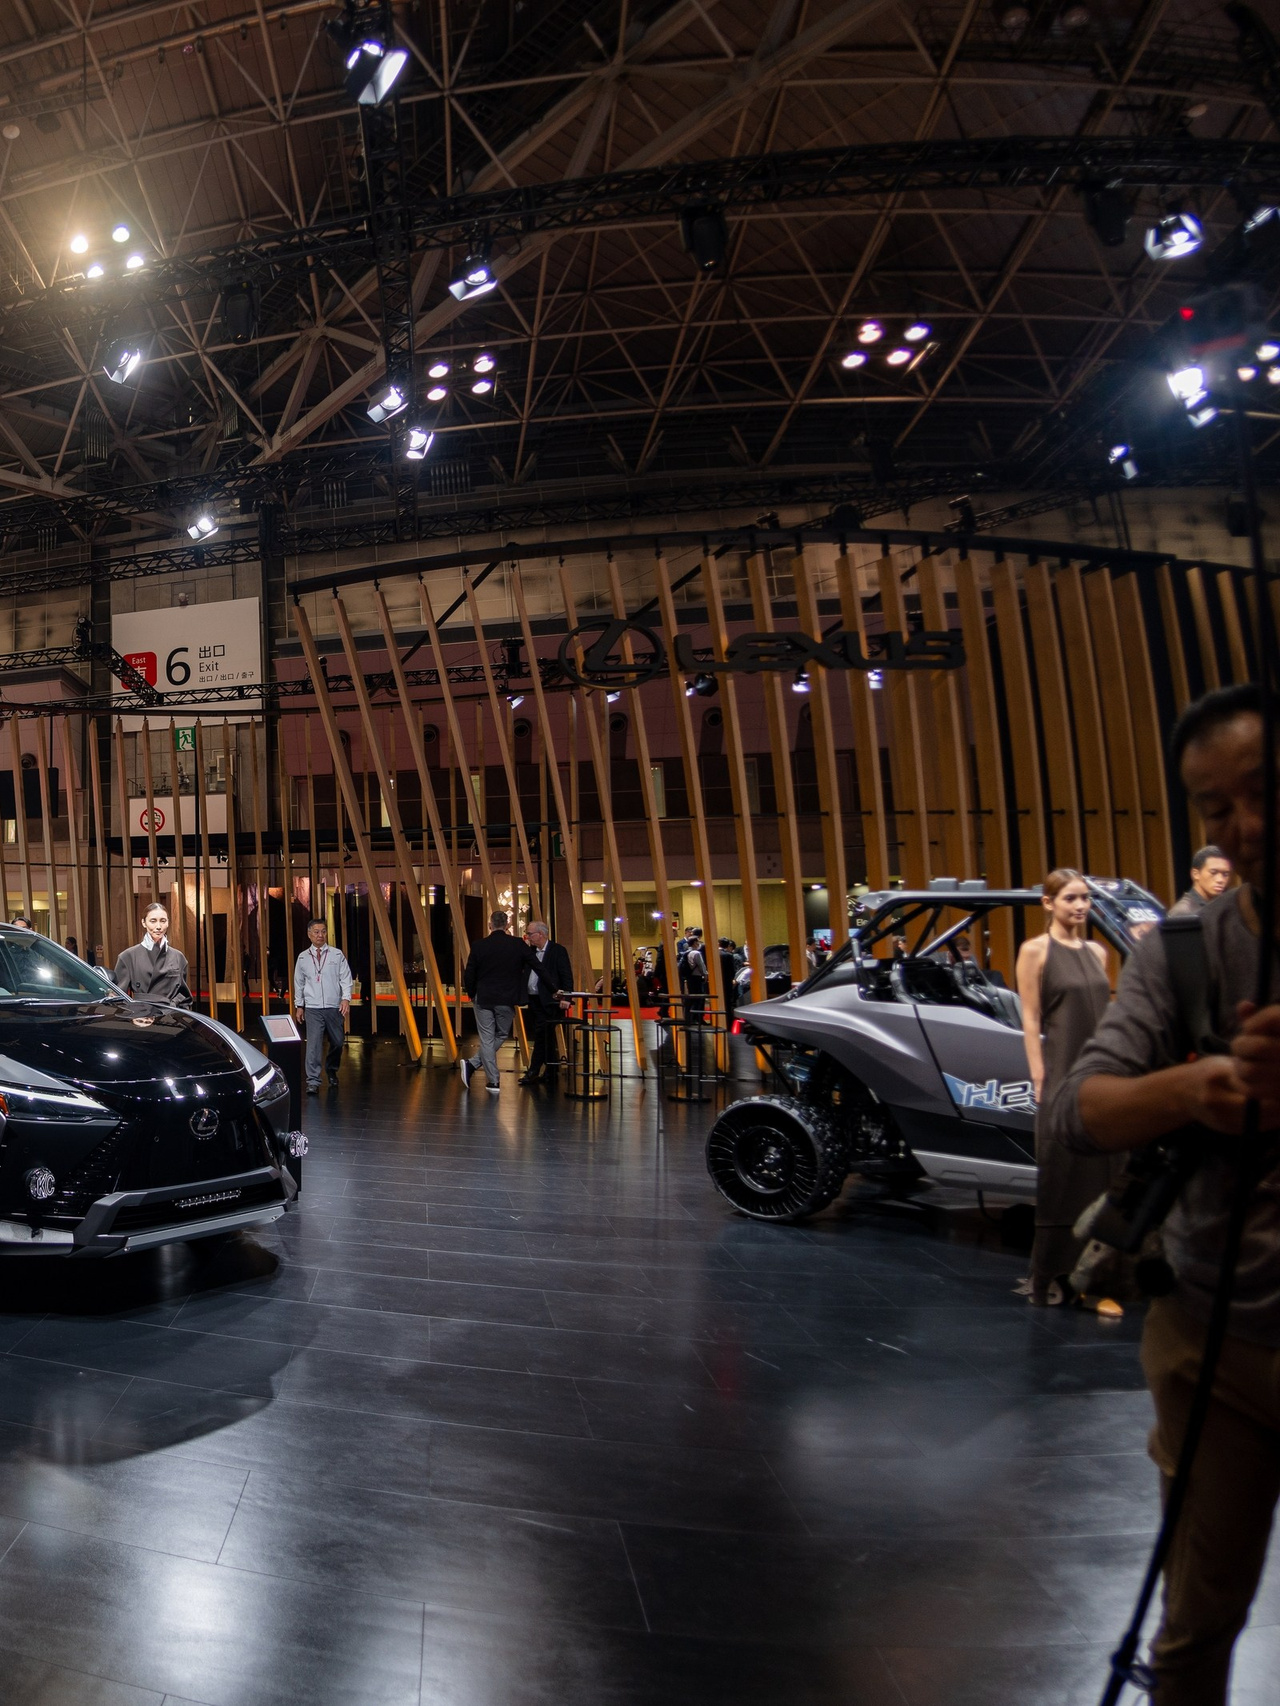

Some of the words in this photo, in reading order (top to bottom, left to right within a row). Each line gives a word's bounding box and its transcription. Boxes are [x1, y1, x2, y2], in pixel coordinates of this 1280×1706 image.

[132, 657, 146, 665] East
[199, 645, 226, 659] 出口
[673, 631, 967, 672] LEXUS
[166, 647, 191, 686] 6
[199, 662, 219, 673] Exit
[199, 675, 213, 683] 出口
[963, 1079, 1032, 1109] H2
[36, 1173, 55, 1198] KC
